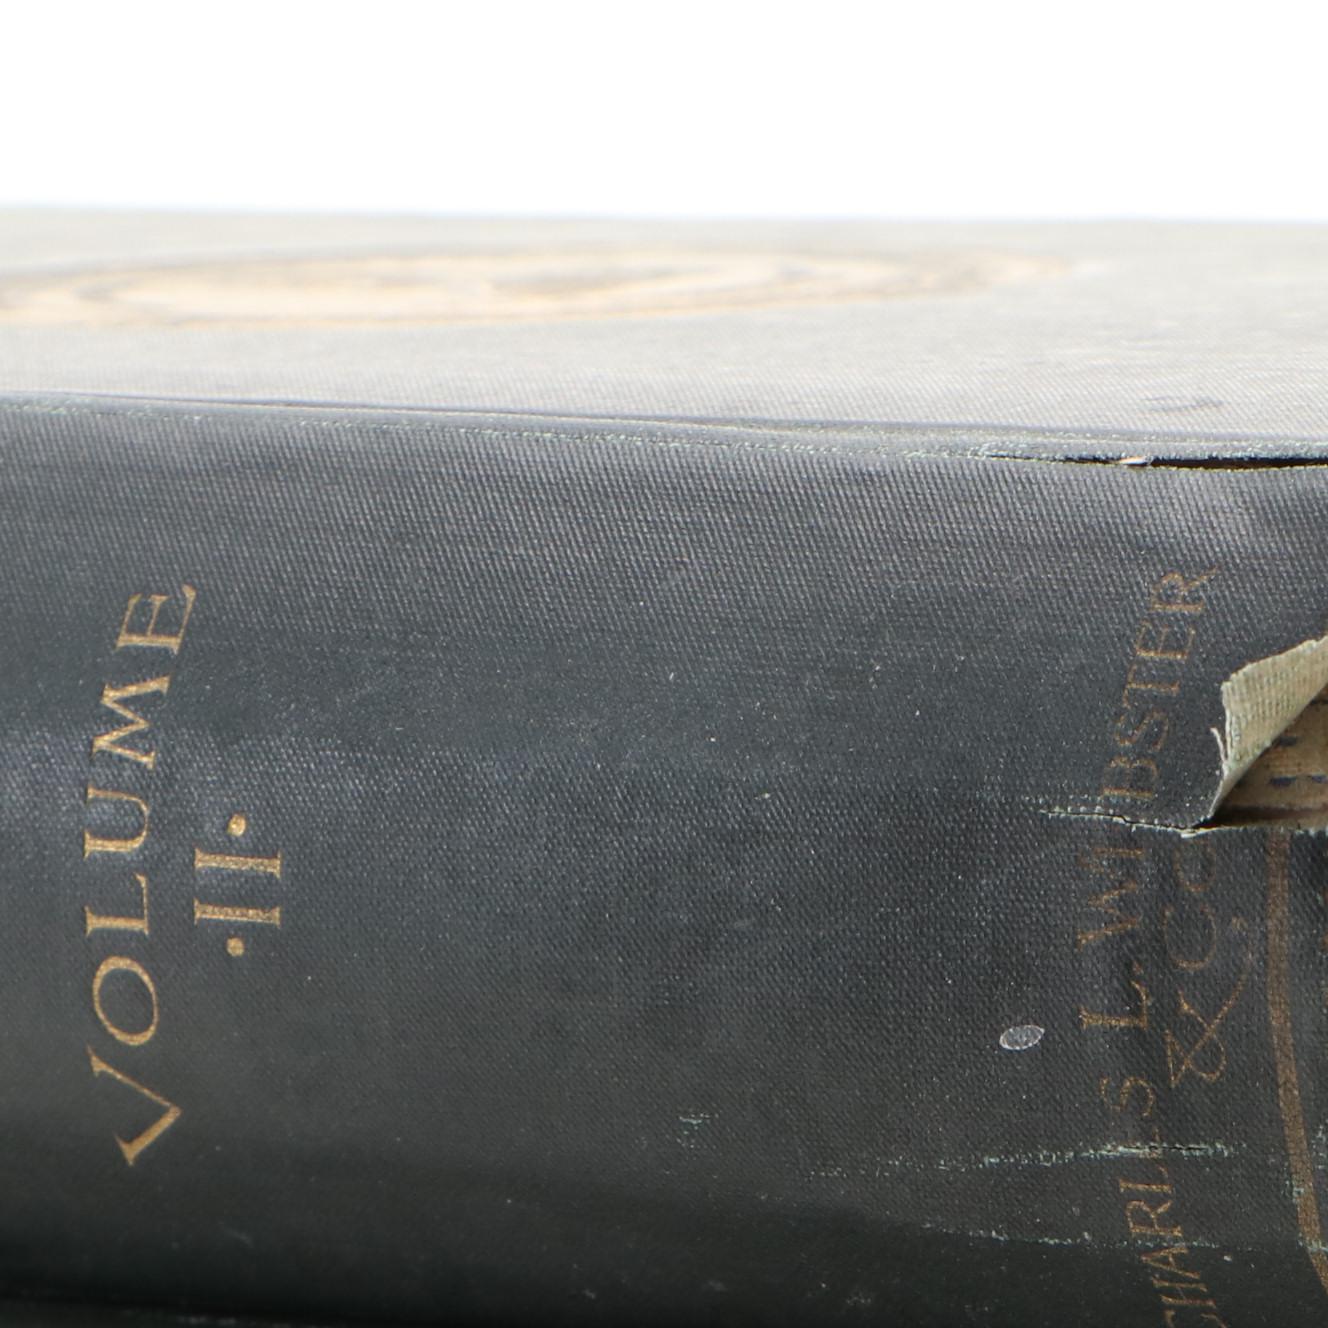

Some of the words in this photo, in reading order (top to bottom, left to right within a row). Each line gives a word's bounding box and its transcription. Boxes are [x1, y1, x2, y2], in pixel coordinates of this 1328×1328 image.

[84, 583, 197, 1167] VOLUME
[1074, 564, 1219, 953] WBSTER
[1077, 960, 1149, 1032] L.
[1164, 914, 1253, 1089] &
